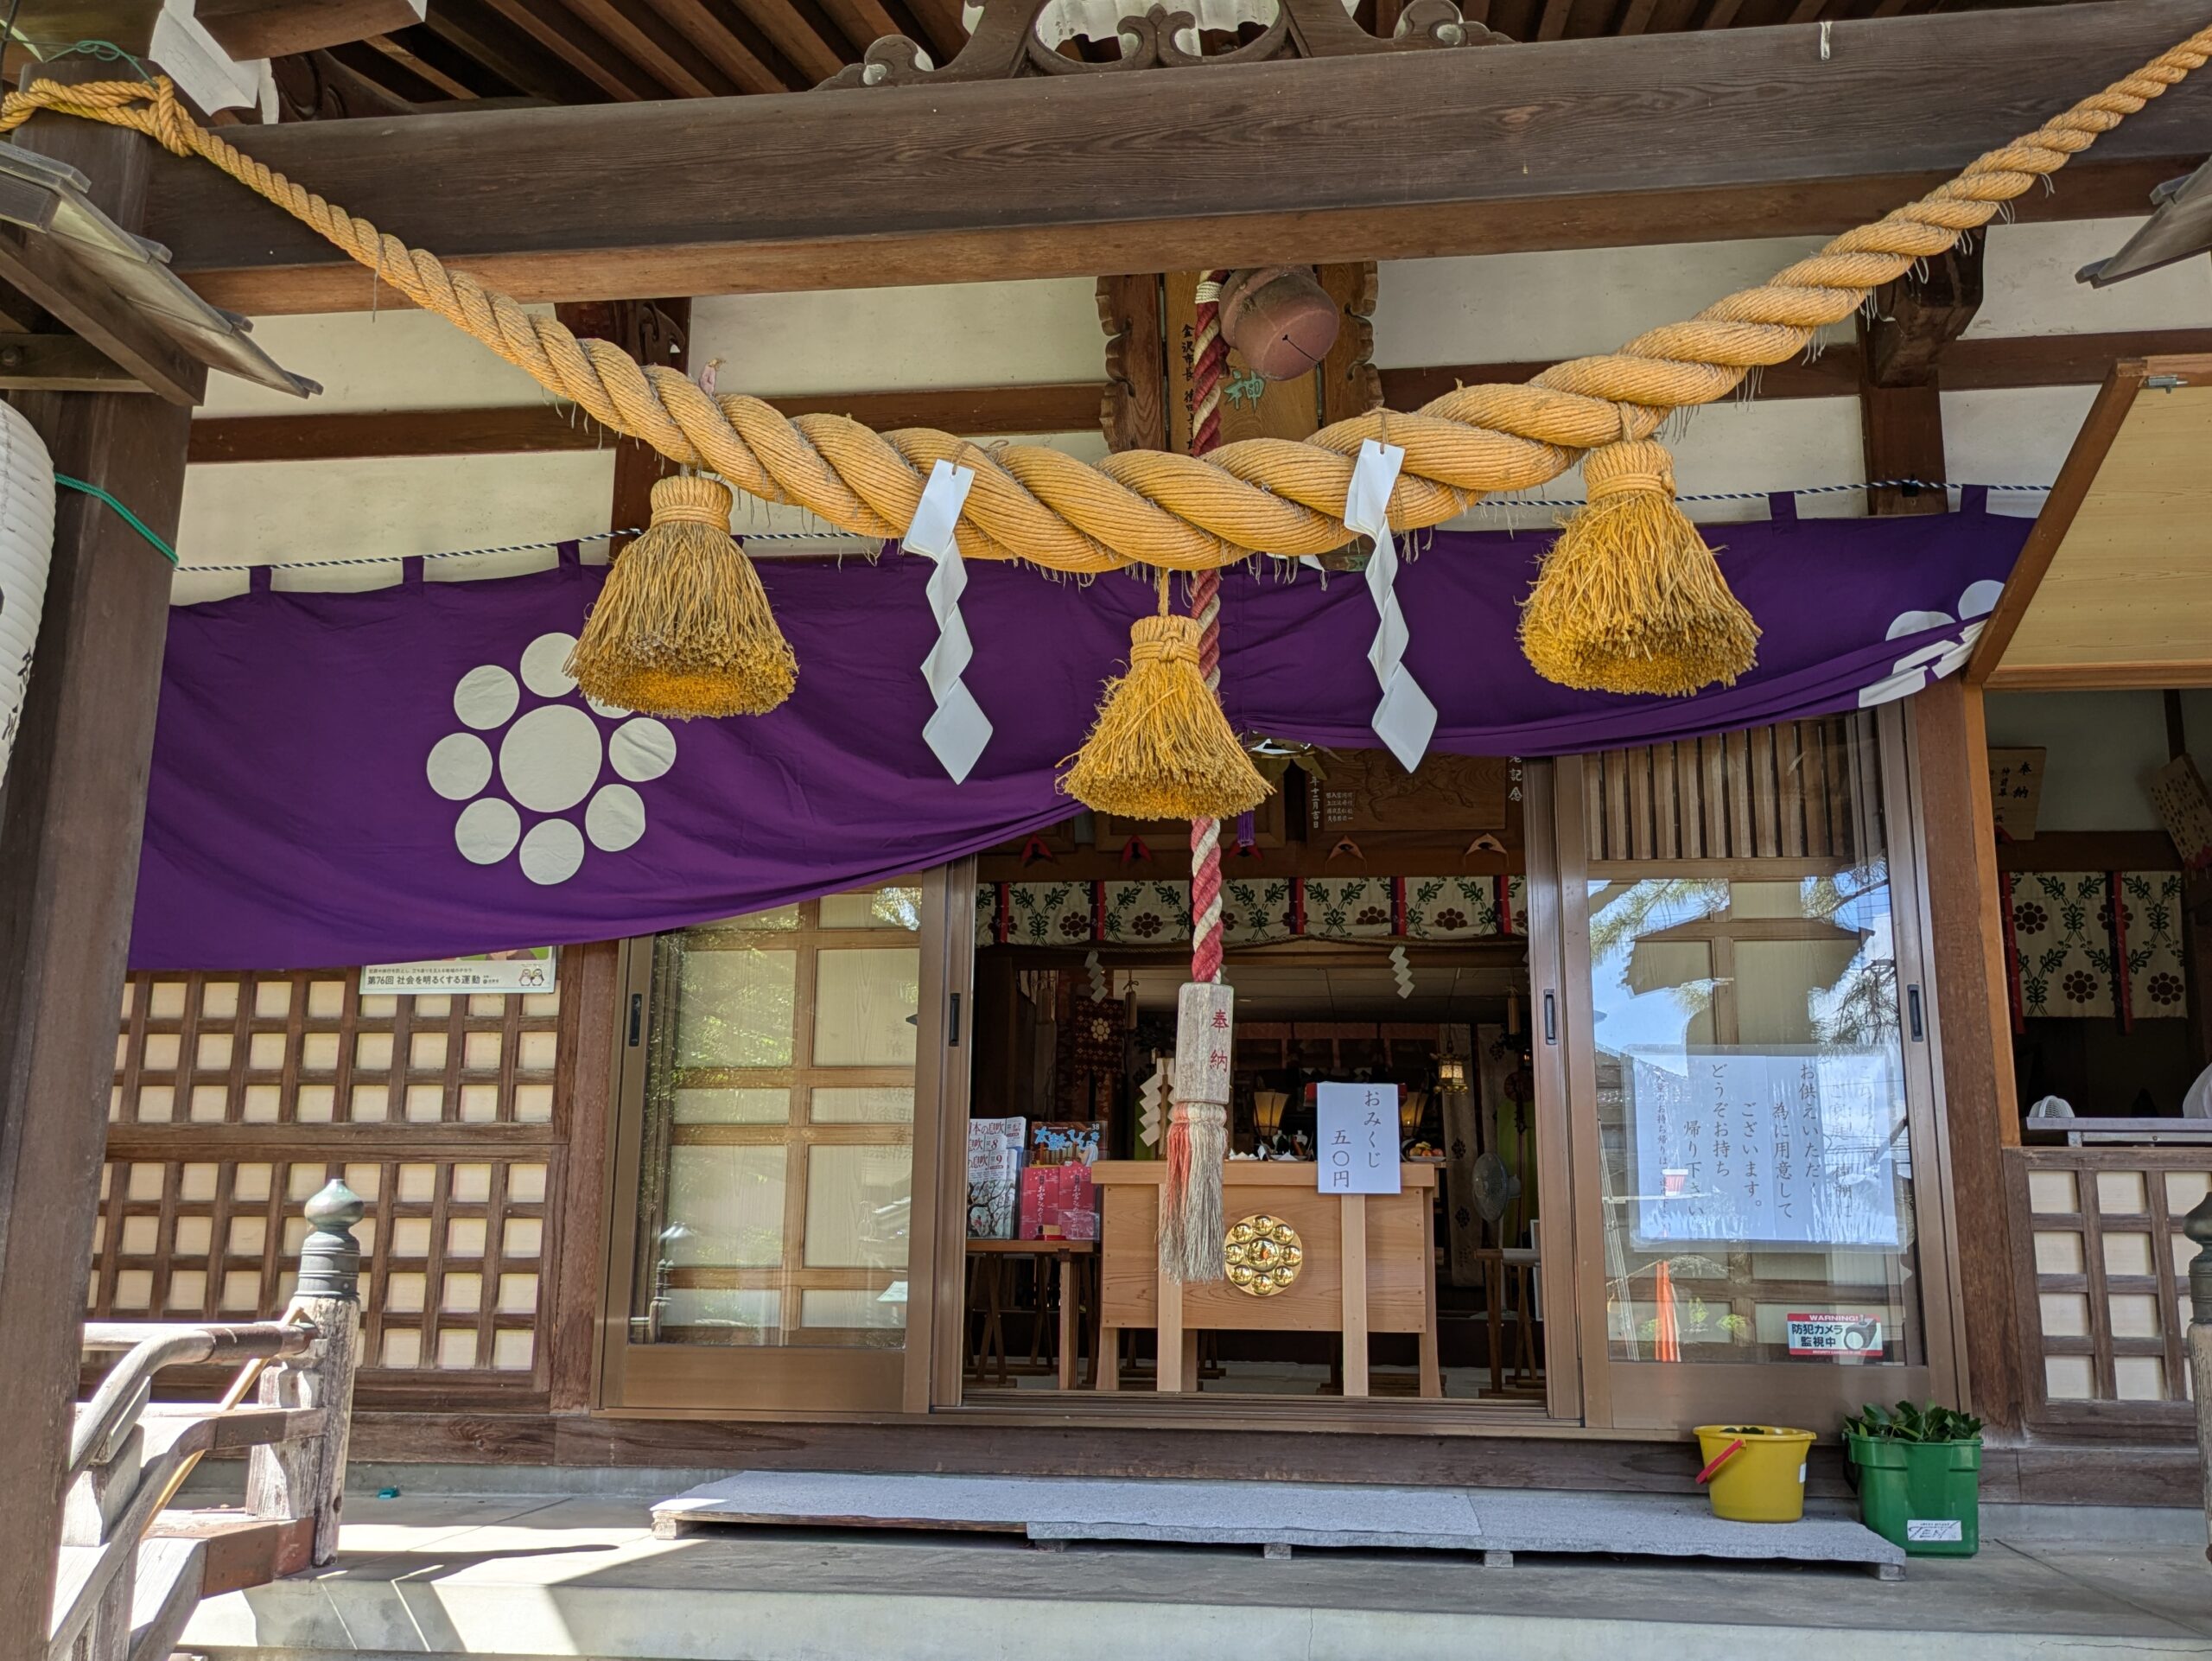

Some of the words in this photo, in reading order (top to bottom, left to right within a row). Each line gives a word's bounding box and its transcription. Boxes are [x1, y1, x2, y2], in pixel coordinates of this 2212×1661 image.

[1224, 368, 1265, 414] 神
[367, 976, 394, 985] 第76回
[397, 975, 480, 985] 社会を明るくする運動
[1210, 1009, 1230, 1072] 奉納
[991, 1138, 999, 1149] 8
[1363, 1090, 1381, 1168] おみくじ
[1712, 1064, 1731, 1177] どうぞお持ち
[1798, 1064, 1821, 1198] お供えいただく
[995, 1155, 1002, 1165] 9
[1684, 1120, 1704, 1216] 帰り下さい
[1742, 1102, 1762, 1206] ございます。
[1772, 1101, 1793, 1219] 為に用意して
[1791, 1324, 1843, 1335] 防犯カメラ
[1801, 1336, 1836, 1347] 監視中
